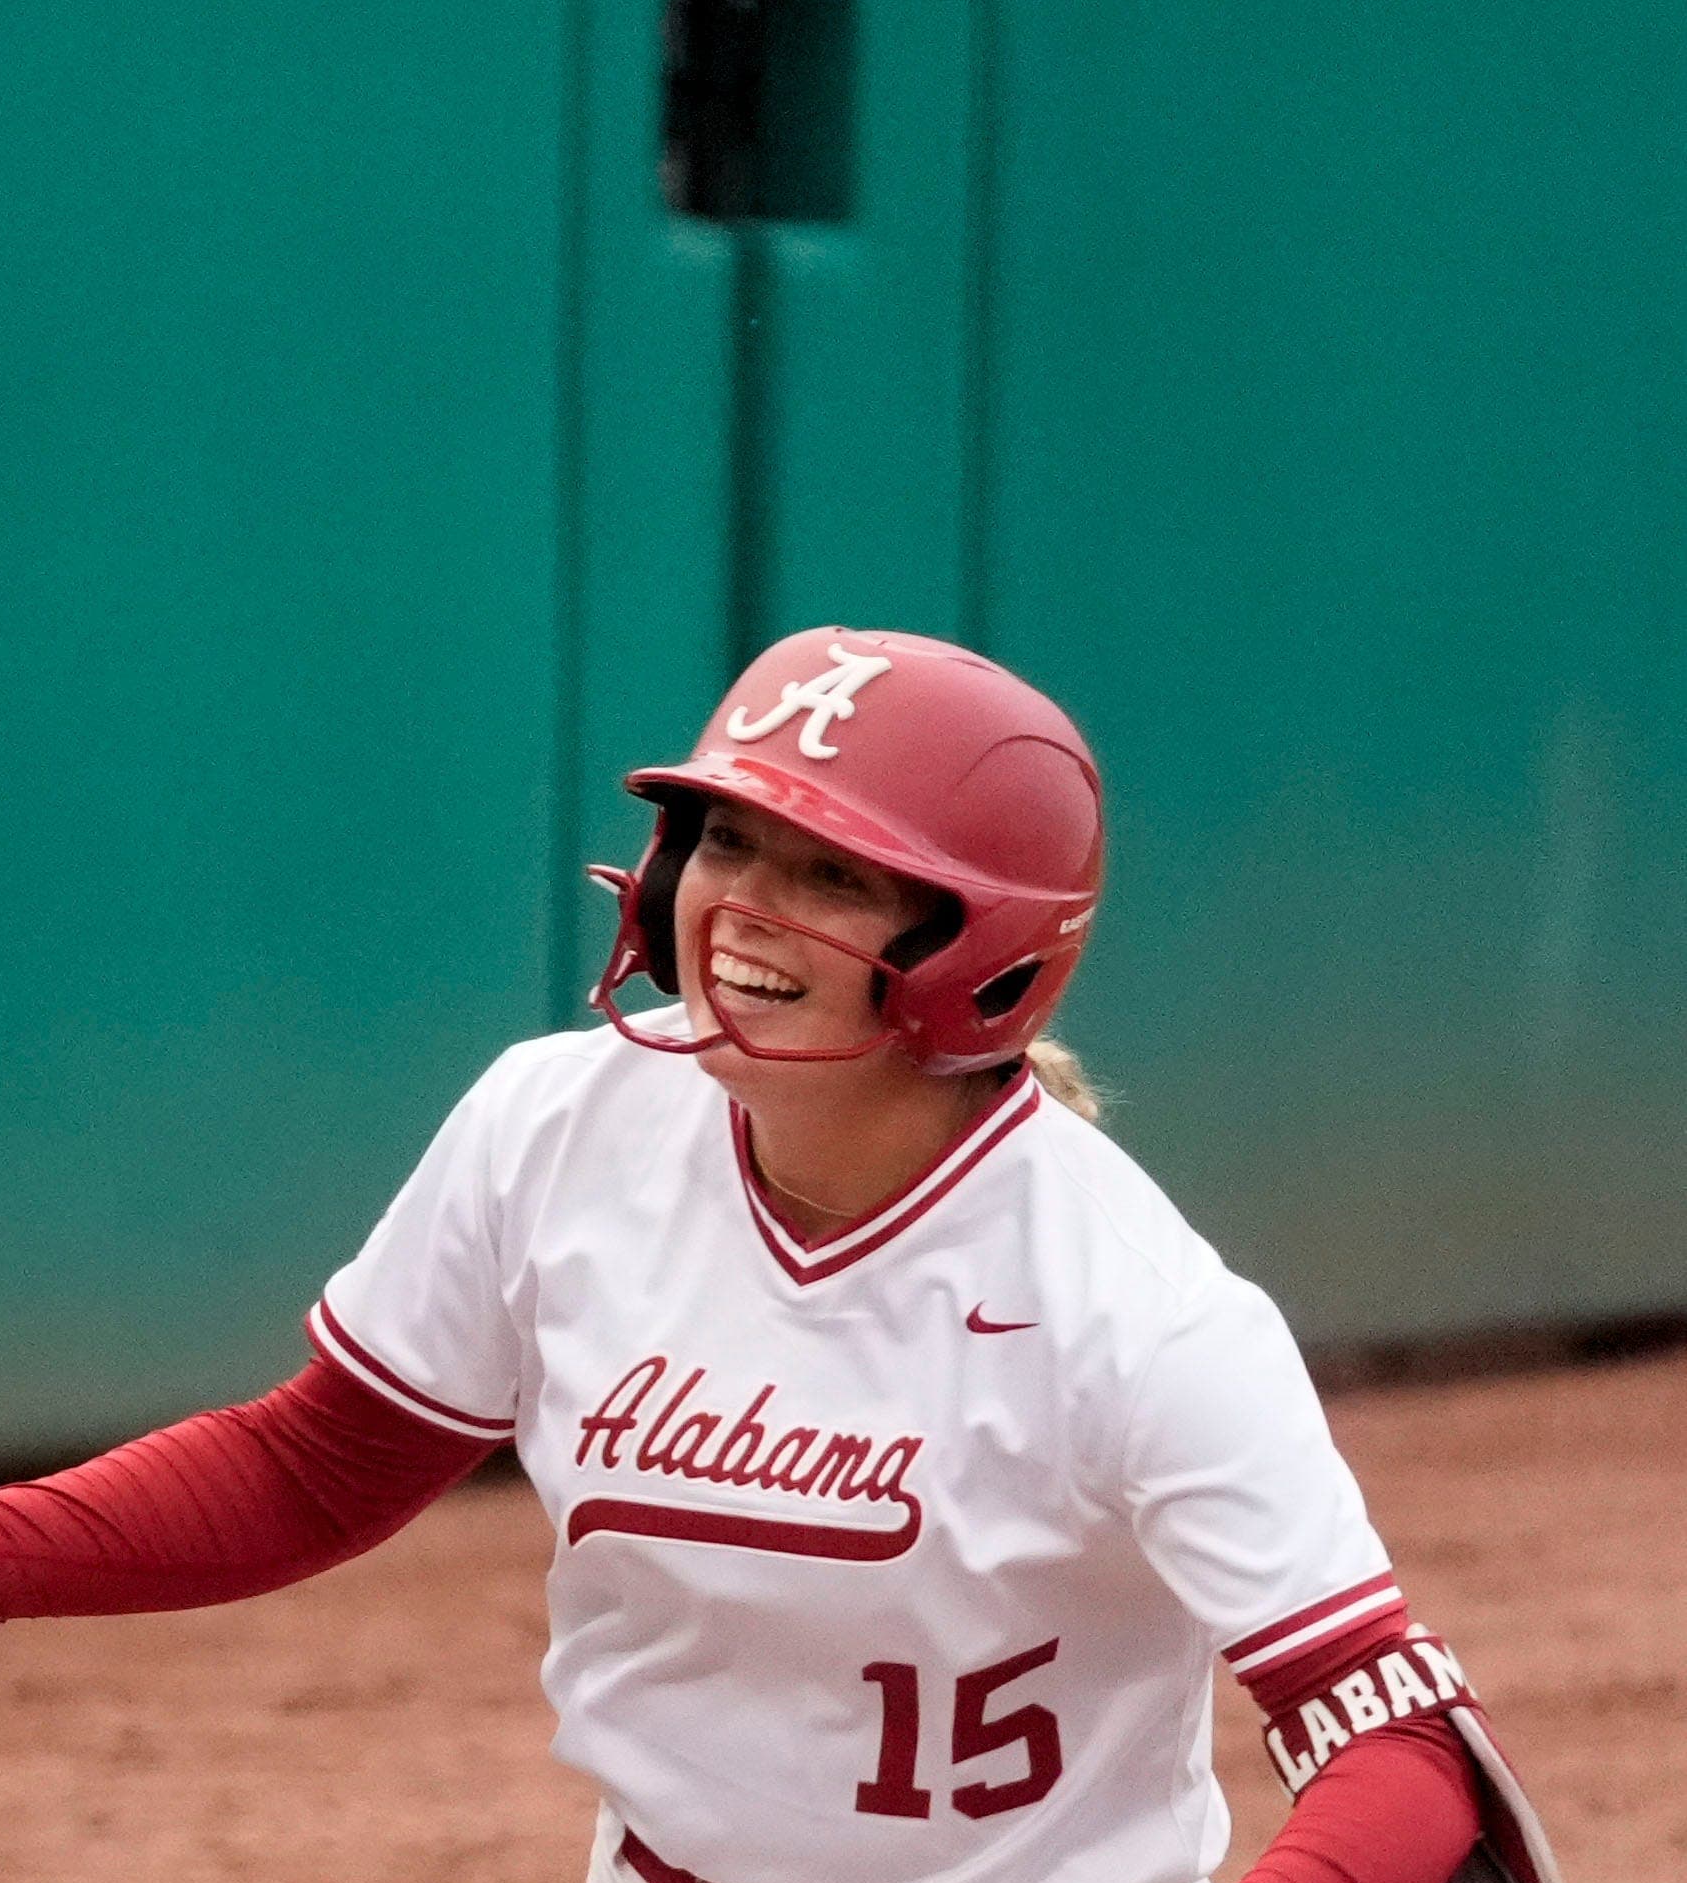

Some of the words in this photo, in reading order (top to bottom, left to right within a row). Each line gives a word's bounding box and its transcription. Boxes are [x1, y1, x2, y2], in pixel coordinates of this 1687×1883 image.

[726, 643, 892, 760] A
[575, 1355, 924, 1502] Alabama
[856, 1636, 1063, 1819] 15
